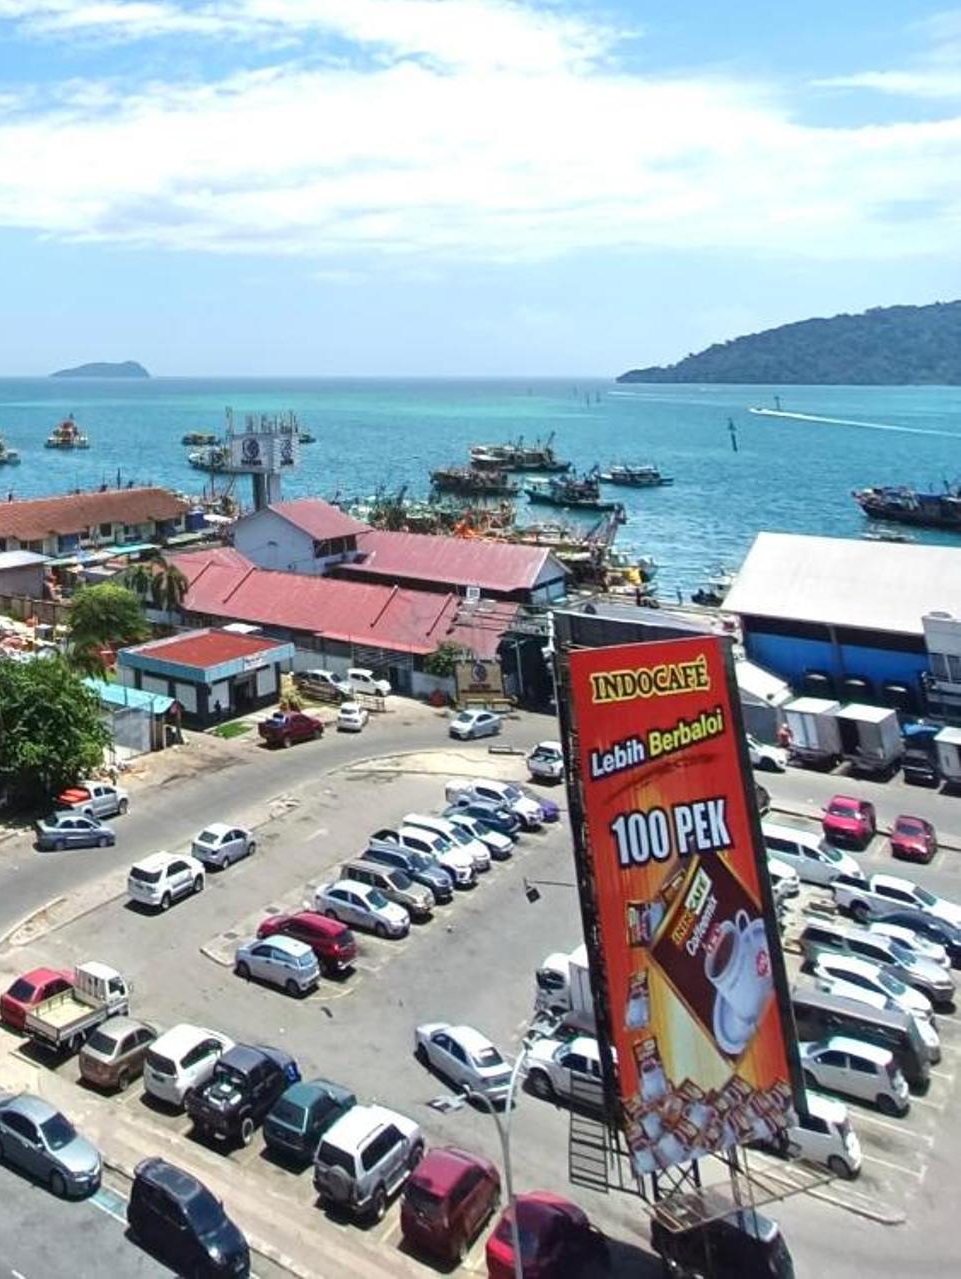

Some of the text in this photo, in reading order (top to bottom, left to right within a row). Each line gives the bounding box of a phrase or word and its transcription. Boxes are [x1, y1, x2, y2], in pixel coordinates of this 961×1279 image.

[593, 655, 709, 702] INDOCAFÉ
[592, 709, 724, 778] Lebih Berbaloi
[613, 799, 731, 864] 100 PEK
